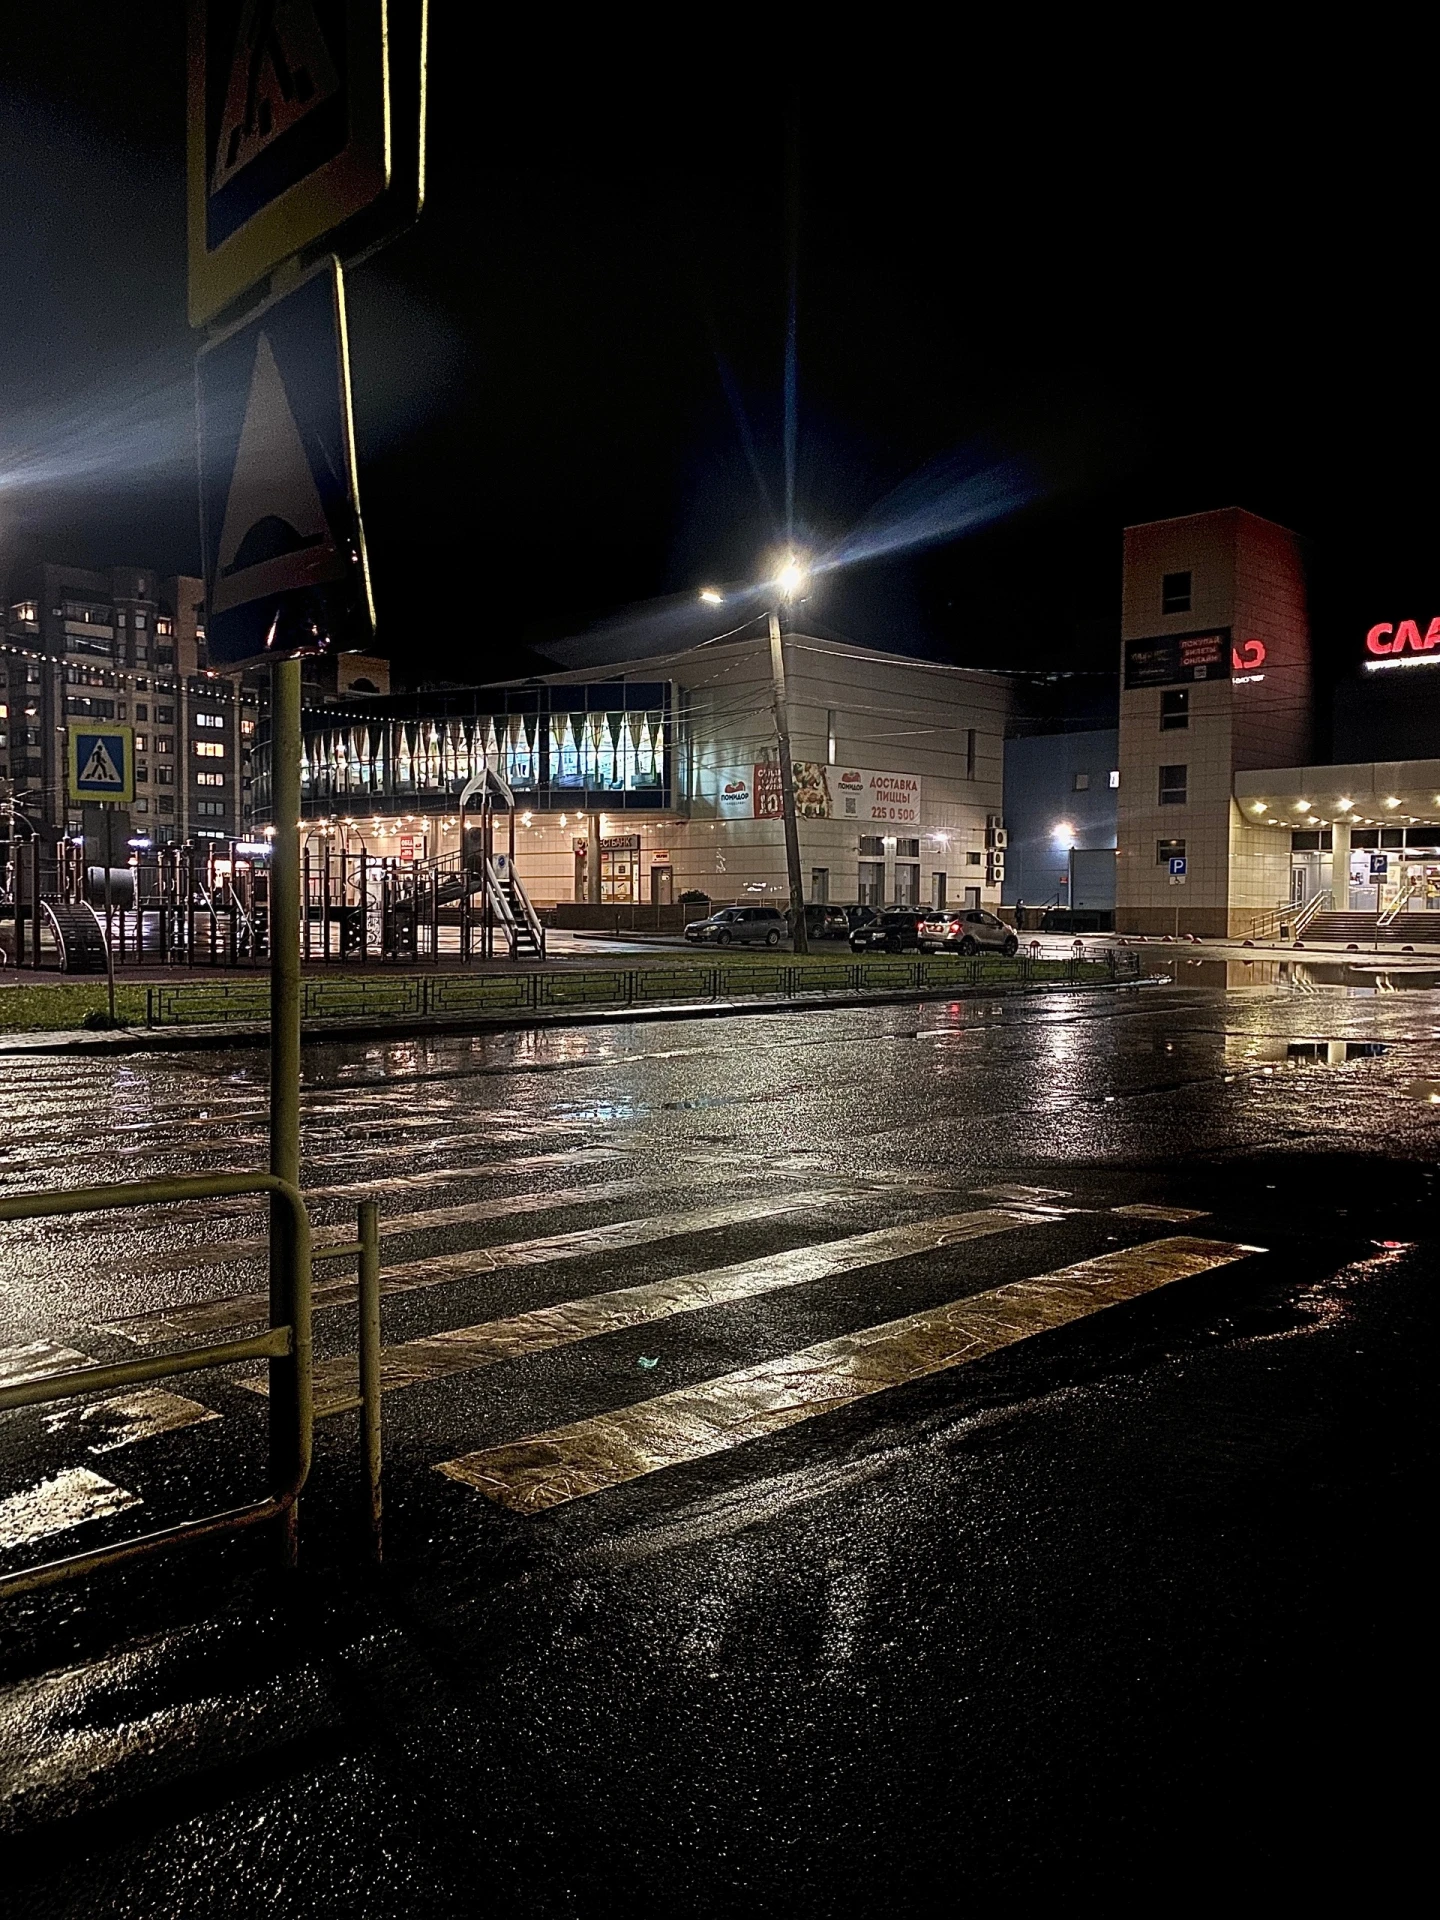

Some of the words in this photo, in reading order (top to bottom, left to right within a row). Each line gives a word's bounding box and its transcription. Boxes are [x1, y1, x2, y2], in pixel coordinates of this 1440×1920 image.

[1184, 646, 1216, 657] БИЛЕТЫ
[1183, 654, 1218, 665] ОНЛАЙН
[838, 782, 863, 791] ПОМИДОР
[870, 776, 918, 791] ДОСТАВКА
[720, 792, 749, 801] ПОМИДОР
[876, 791, 910, 804] ПИЦЦЫ
[871, 807, 887, 818] 225
[889, 808, 895, 819] 0
[898, 808, 915, 821] 500
[1174, 859, 1184, 872] P
